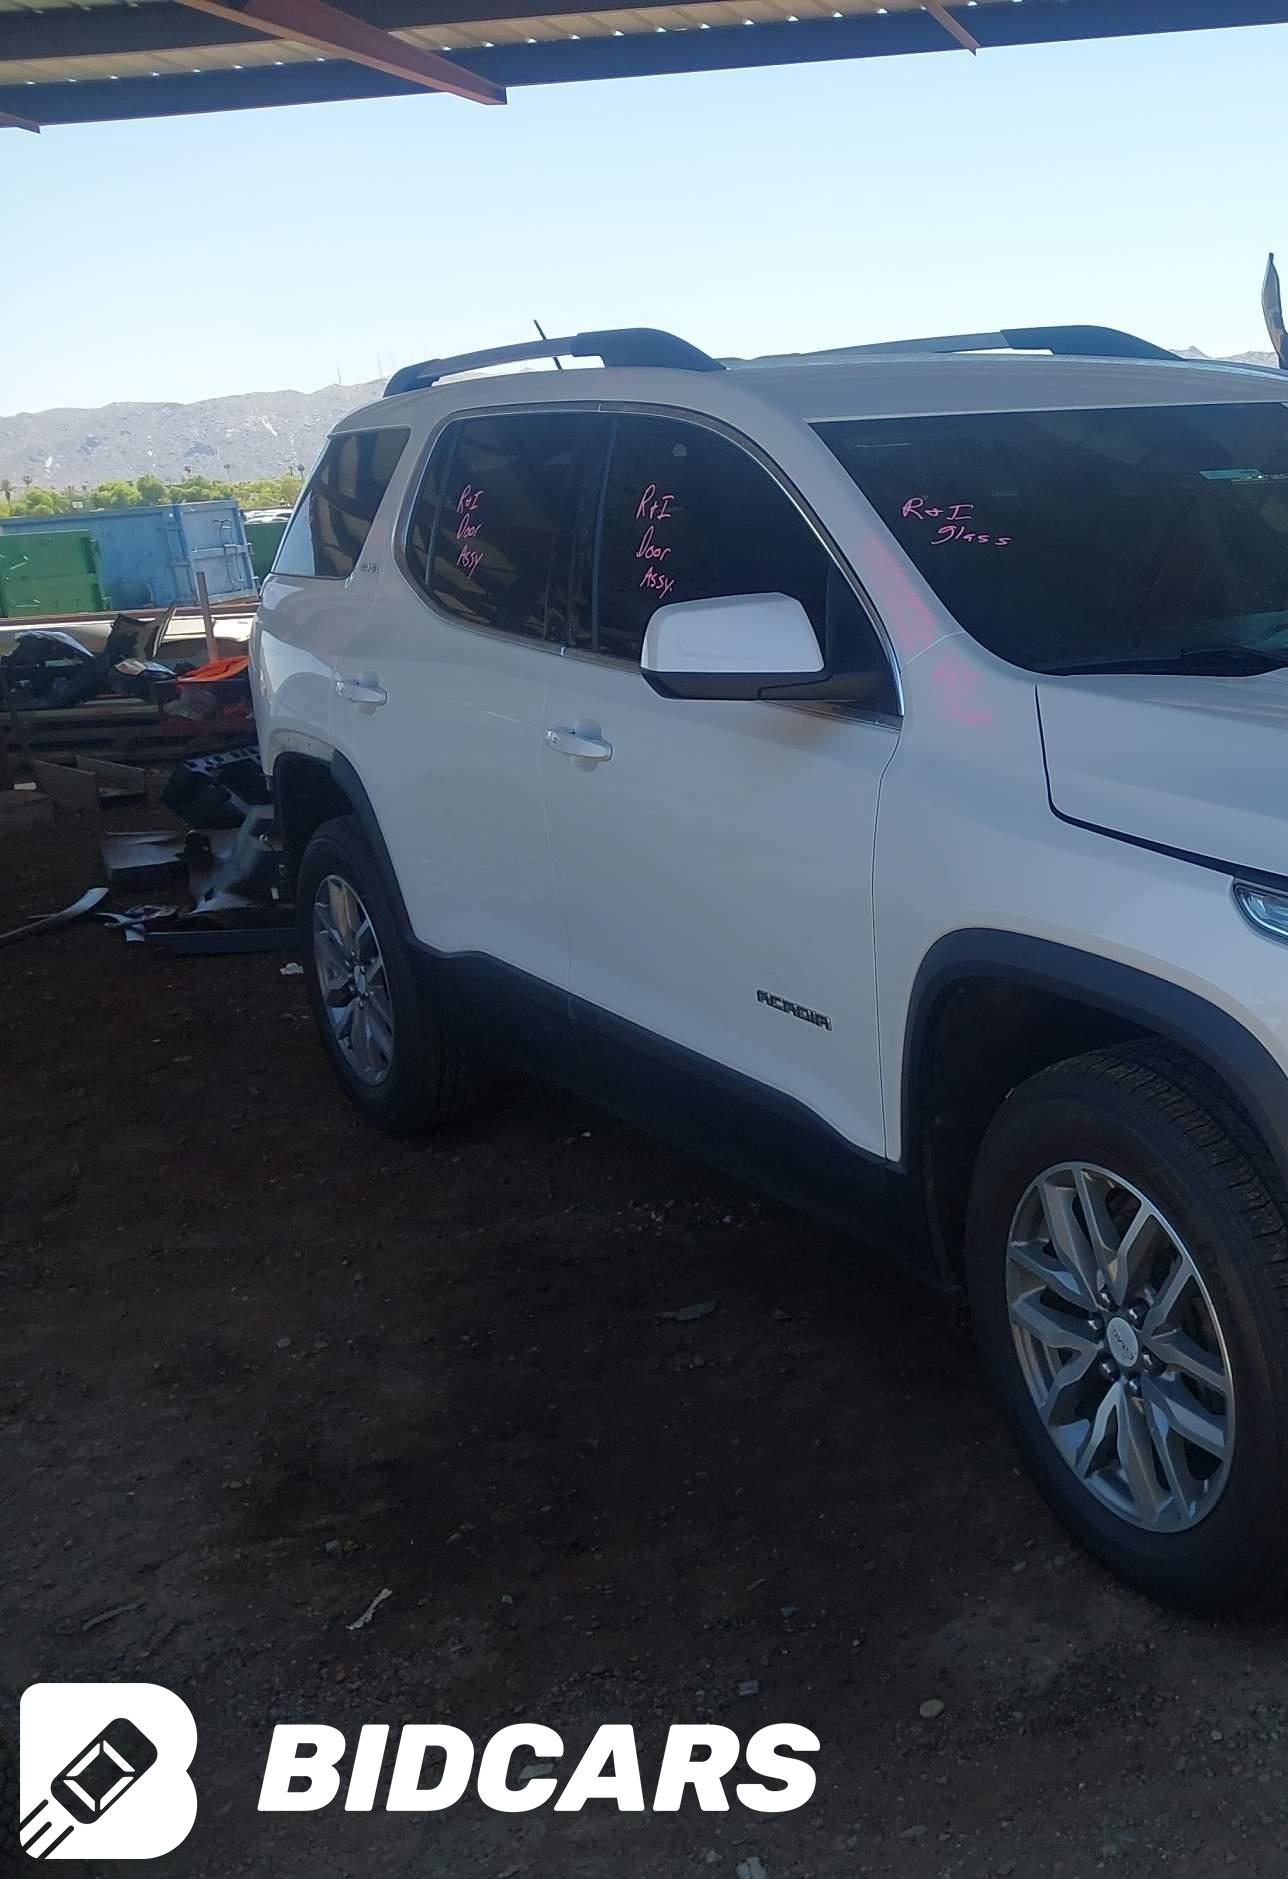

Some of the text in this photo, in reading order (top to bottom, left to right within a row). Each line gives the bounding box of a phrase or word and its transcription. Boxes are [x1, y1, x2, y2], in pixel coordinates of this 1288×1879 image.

[456, 513, 482, 540] Door
[636, 526, 672, 560] Door
[756, 989, 833, 1032] ACADIA
